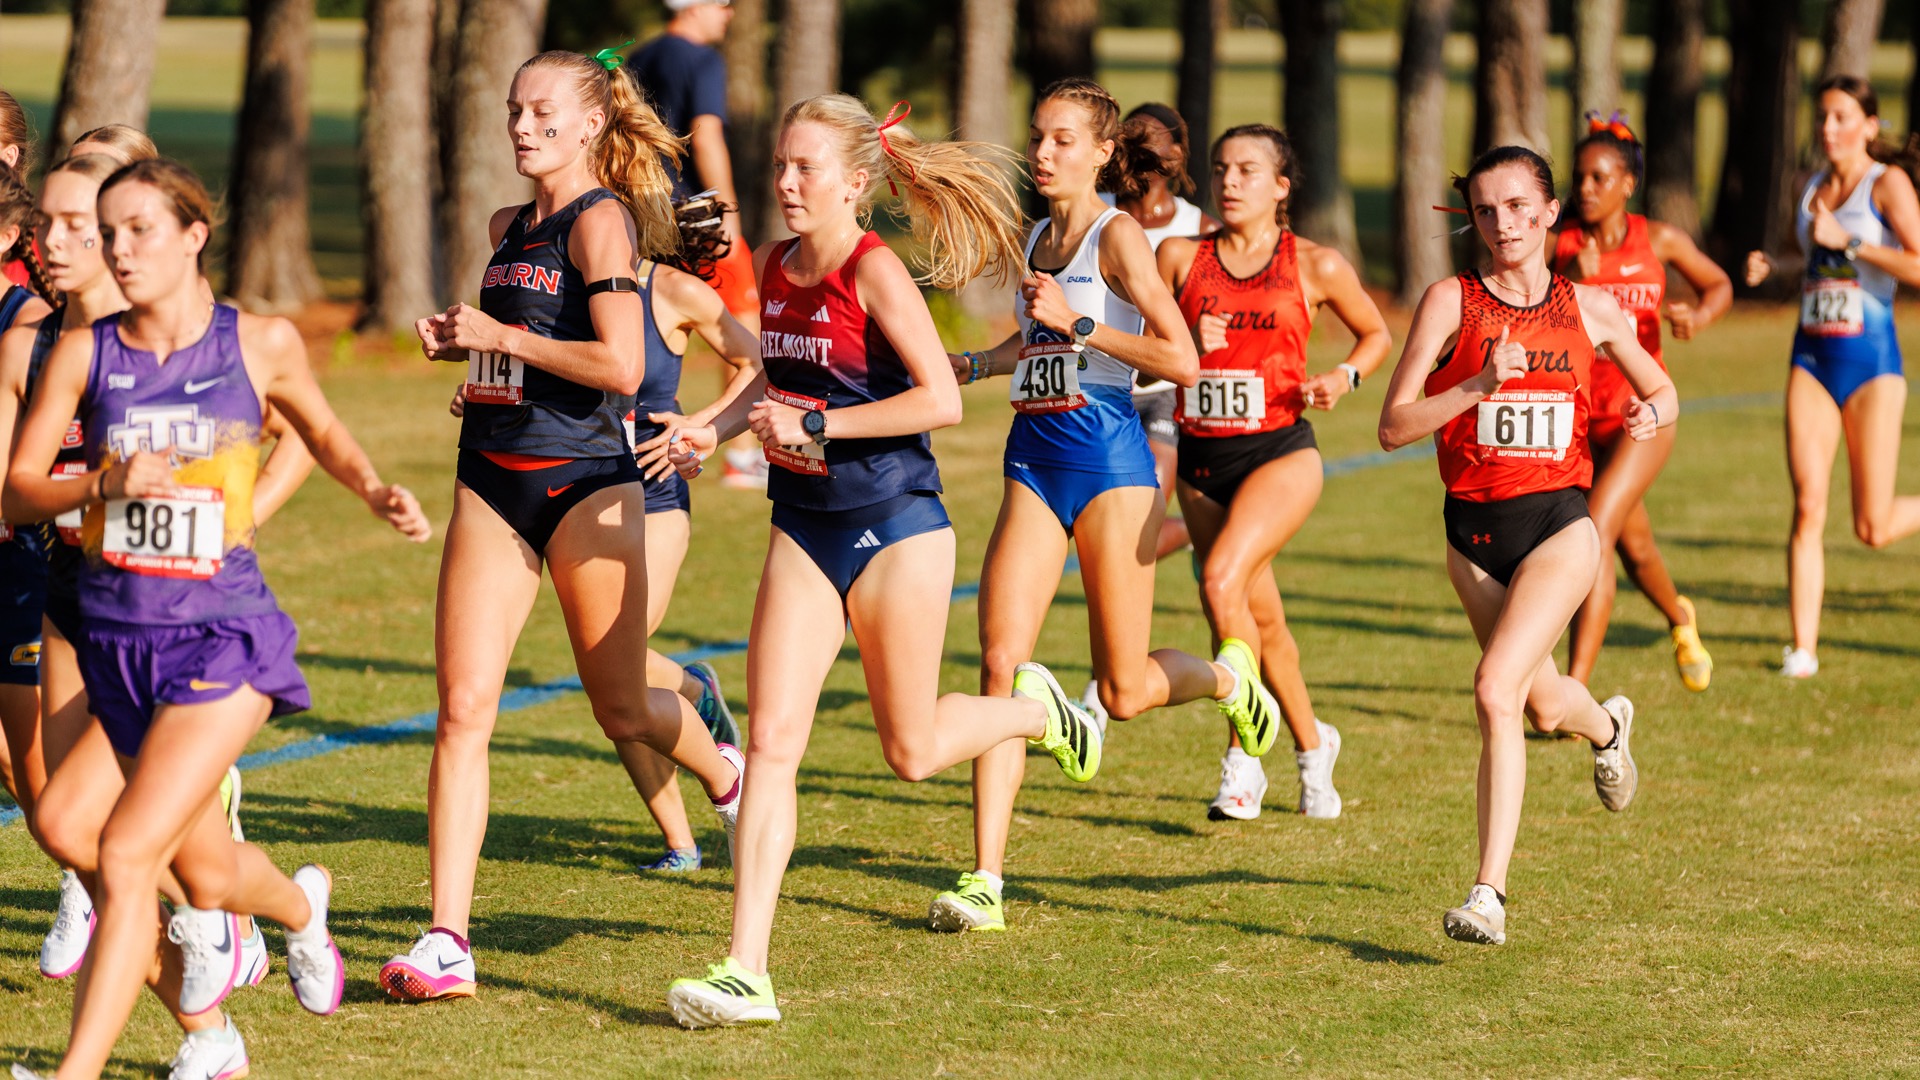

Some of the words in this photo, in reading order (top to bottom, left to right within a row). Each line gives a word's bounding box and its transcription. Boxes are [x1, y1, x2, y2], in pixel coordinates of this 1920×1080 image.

[762, 331, 833, 367] BELMONT
[1043, 344, 1073, 353] SHOWCAS
[1020, 355, 1066, 398] 430
[784, 395, 818, 411] SHOWCASE
[1198, 381, 1248, 417] 615
[1490, 393, 1528, 401] SOUTHERN
[1528, 393, 1566, 402] SHOWCASE
[1495, 405, 1555, 446] 611
[1497, 450, 1529, 458] SEPTEMBER
[126, 501, 197, 558] 981
